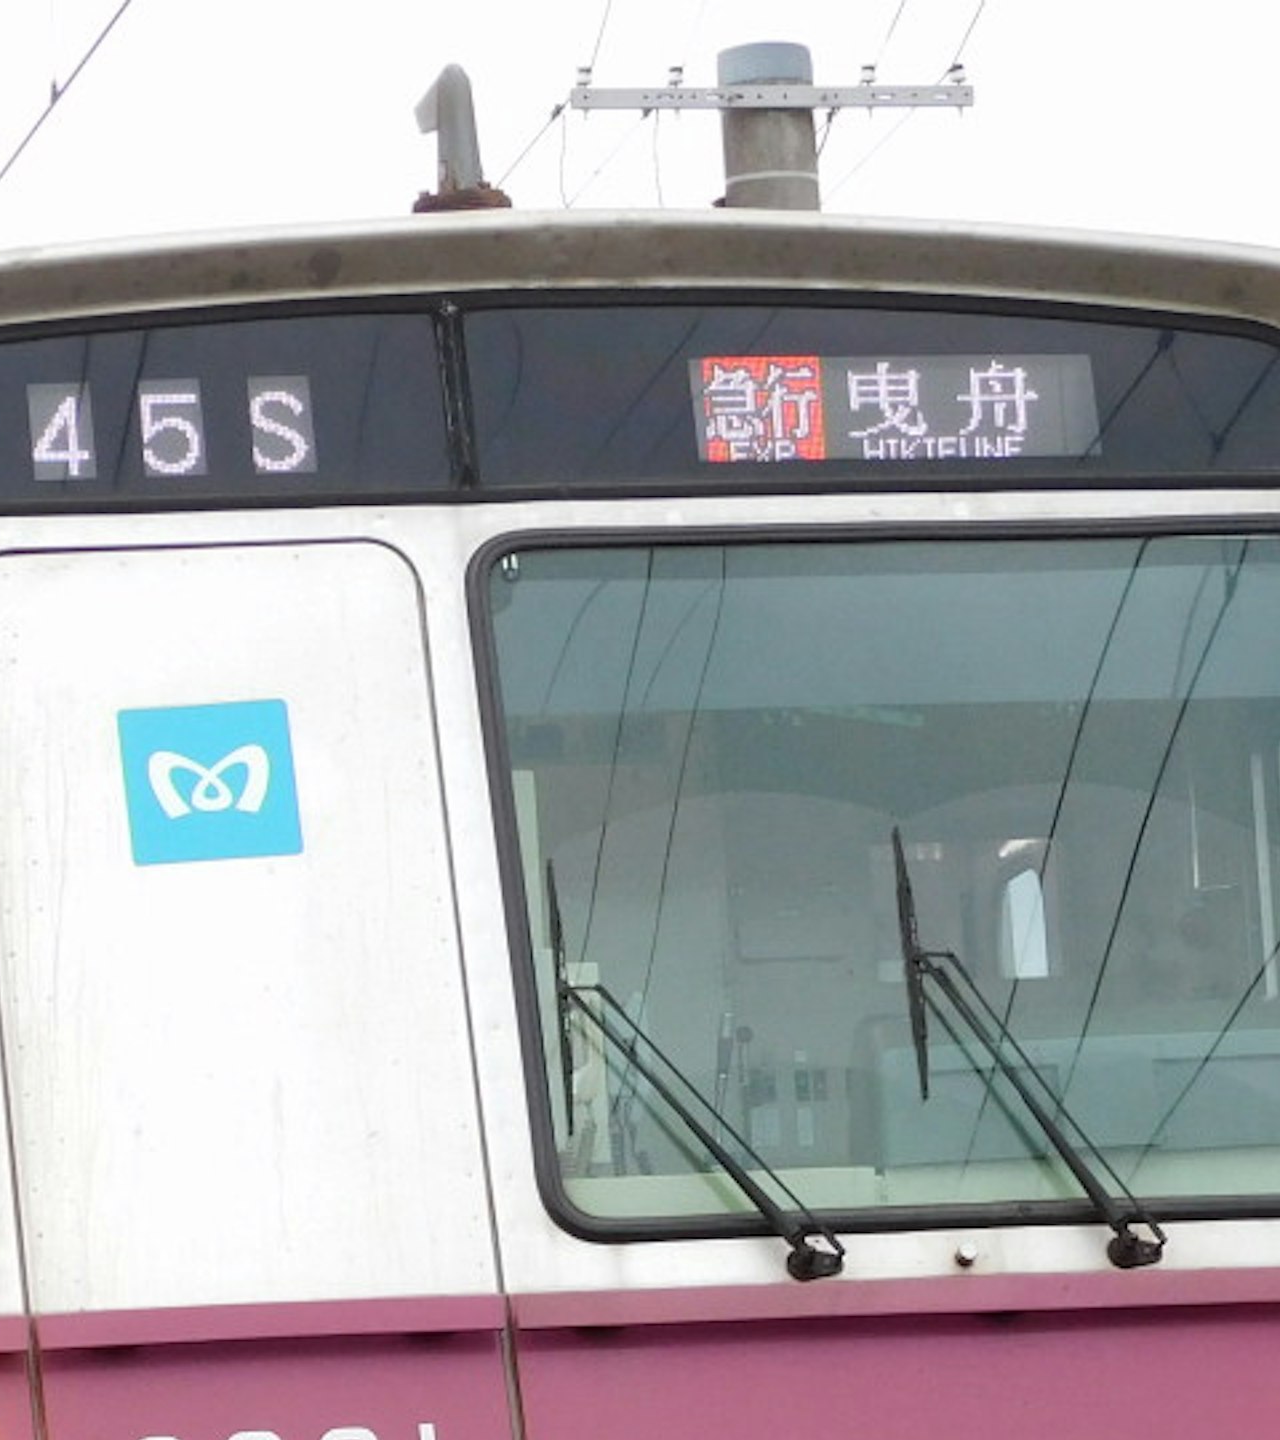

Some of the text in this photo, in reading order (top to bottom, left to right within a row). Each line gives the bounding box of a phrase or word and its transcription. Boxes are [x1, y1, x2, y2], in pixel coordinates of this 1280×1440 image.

[704, 360, 1039, 439] 急行 曳舟
[730, 440, 797, 462] EXP
